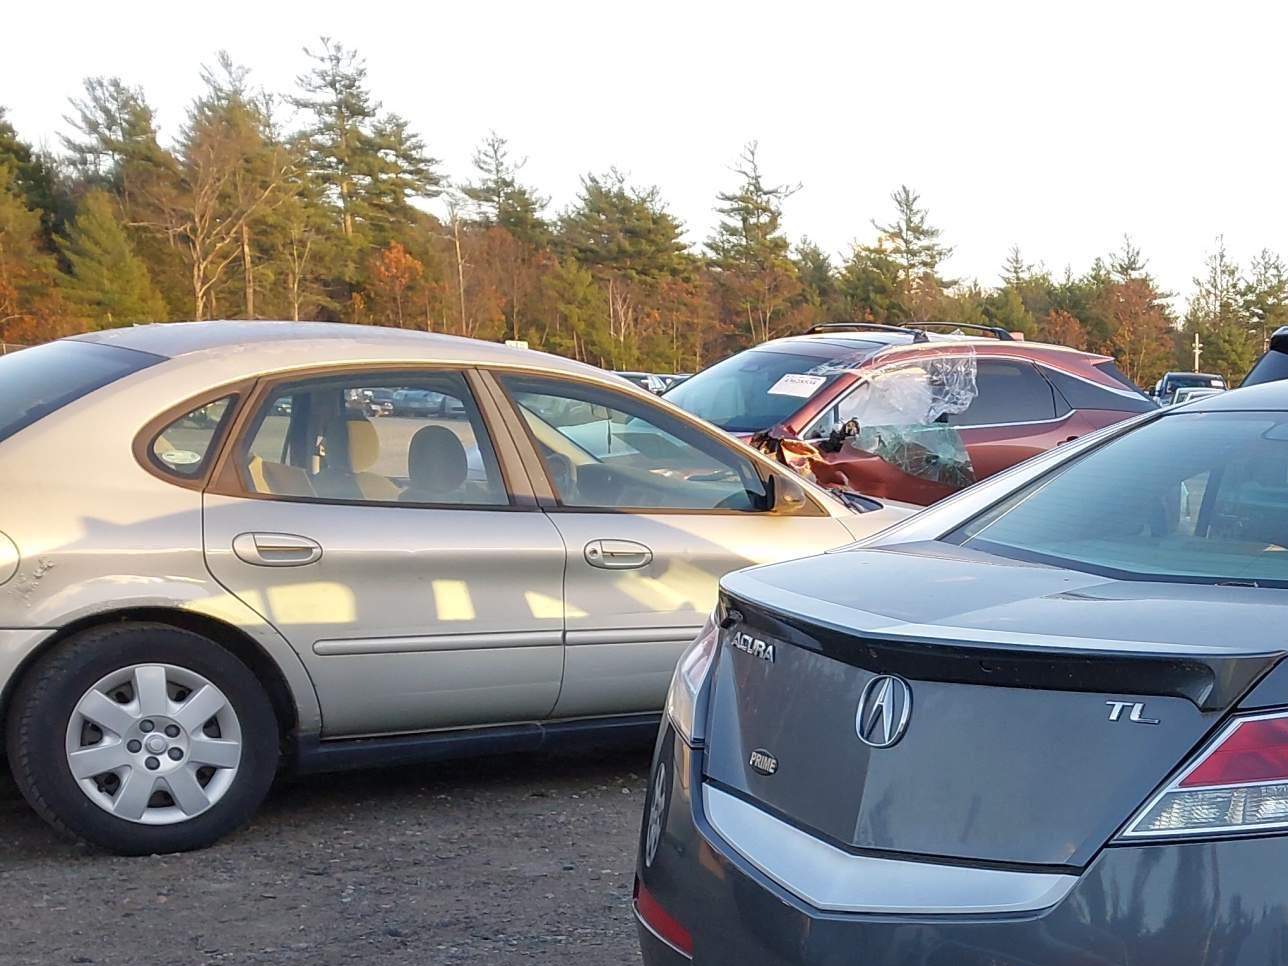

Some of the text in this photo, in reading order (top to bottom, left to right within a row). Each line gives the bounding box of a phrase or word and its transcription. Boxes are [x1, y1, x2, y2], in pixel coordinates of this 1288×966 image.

[730, 631, 775, 663] ACURA
[1105, 701, 1161, 725] TL
[749, 751, 777, 774] PRIME
